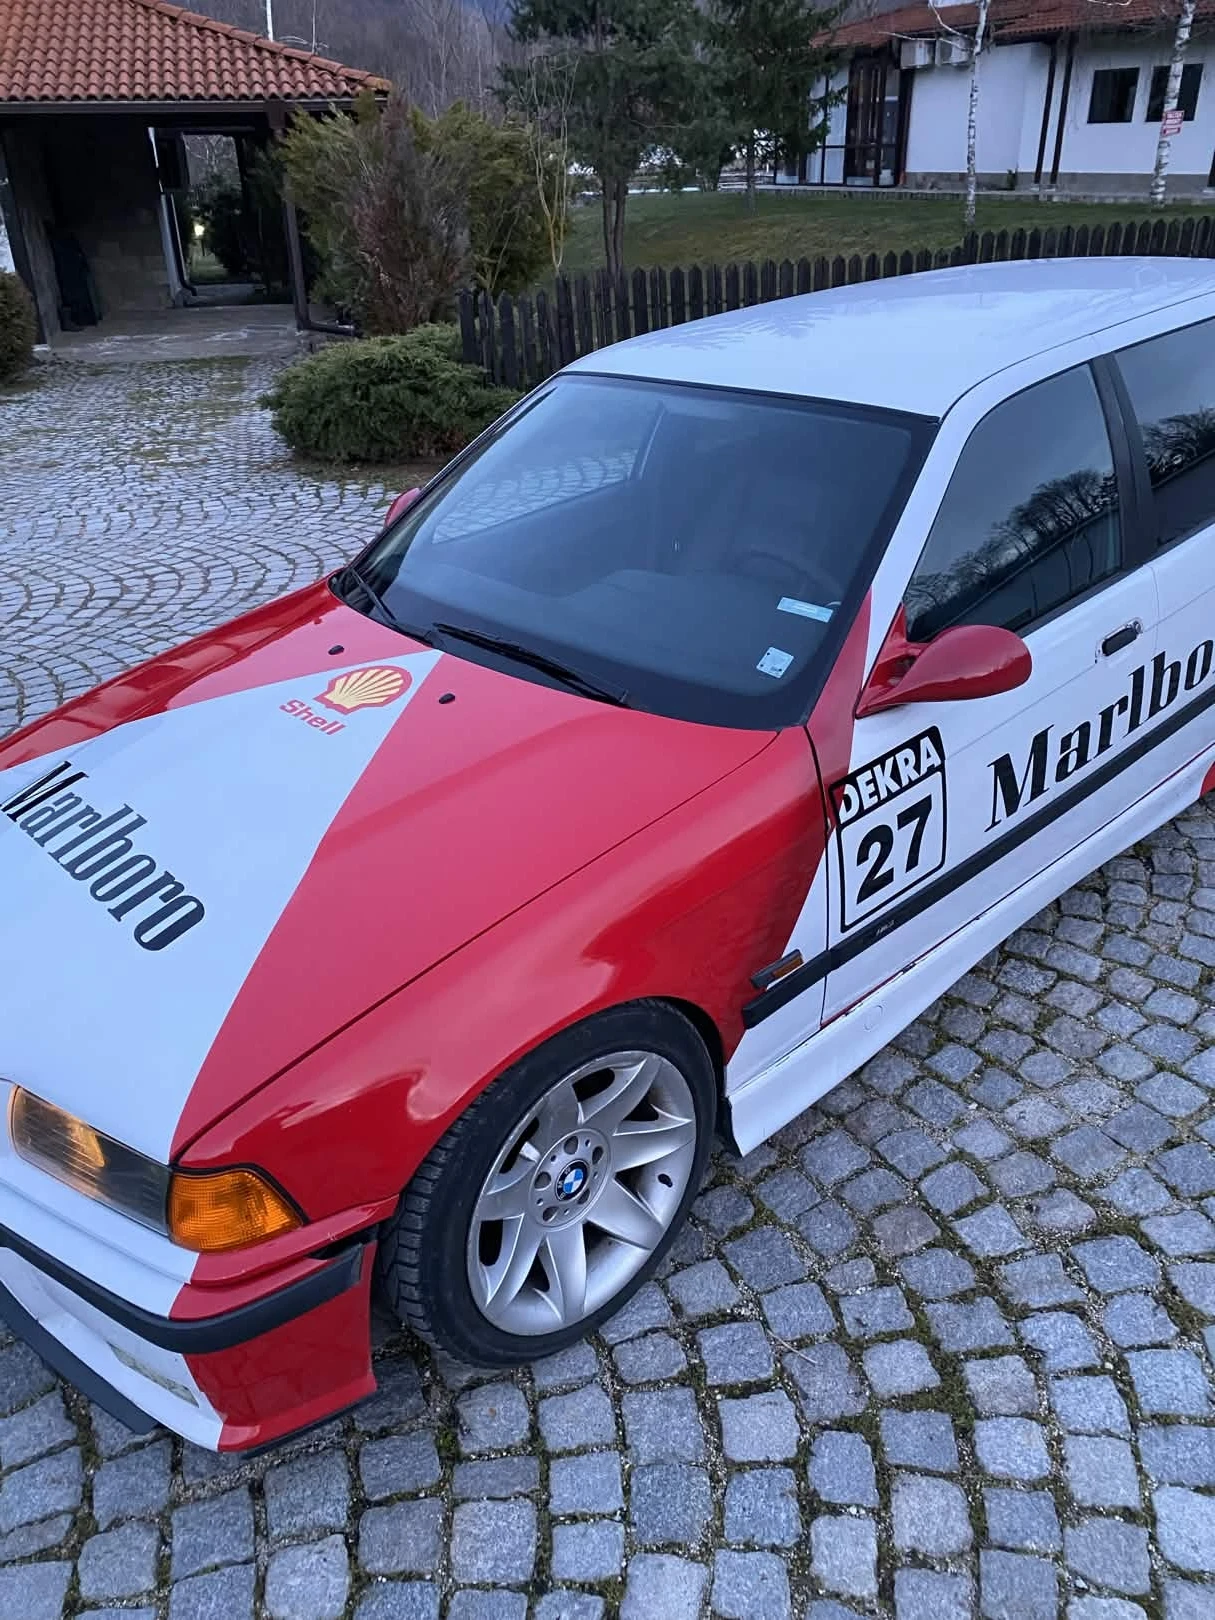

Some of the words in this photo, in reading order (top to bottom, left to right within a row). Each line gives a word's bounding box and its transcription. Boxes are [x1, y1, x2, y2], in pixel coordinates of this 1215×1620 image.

[279, 699, 347, 735] Shell
[984, 639, 1215, 832] Marlbo
[839, 735, 942, 824] DEKRA
[0, 761, 205, 951] Marlboro
[856, 794, 932, 905] 27
